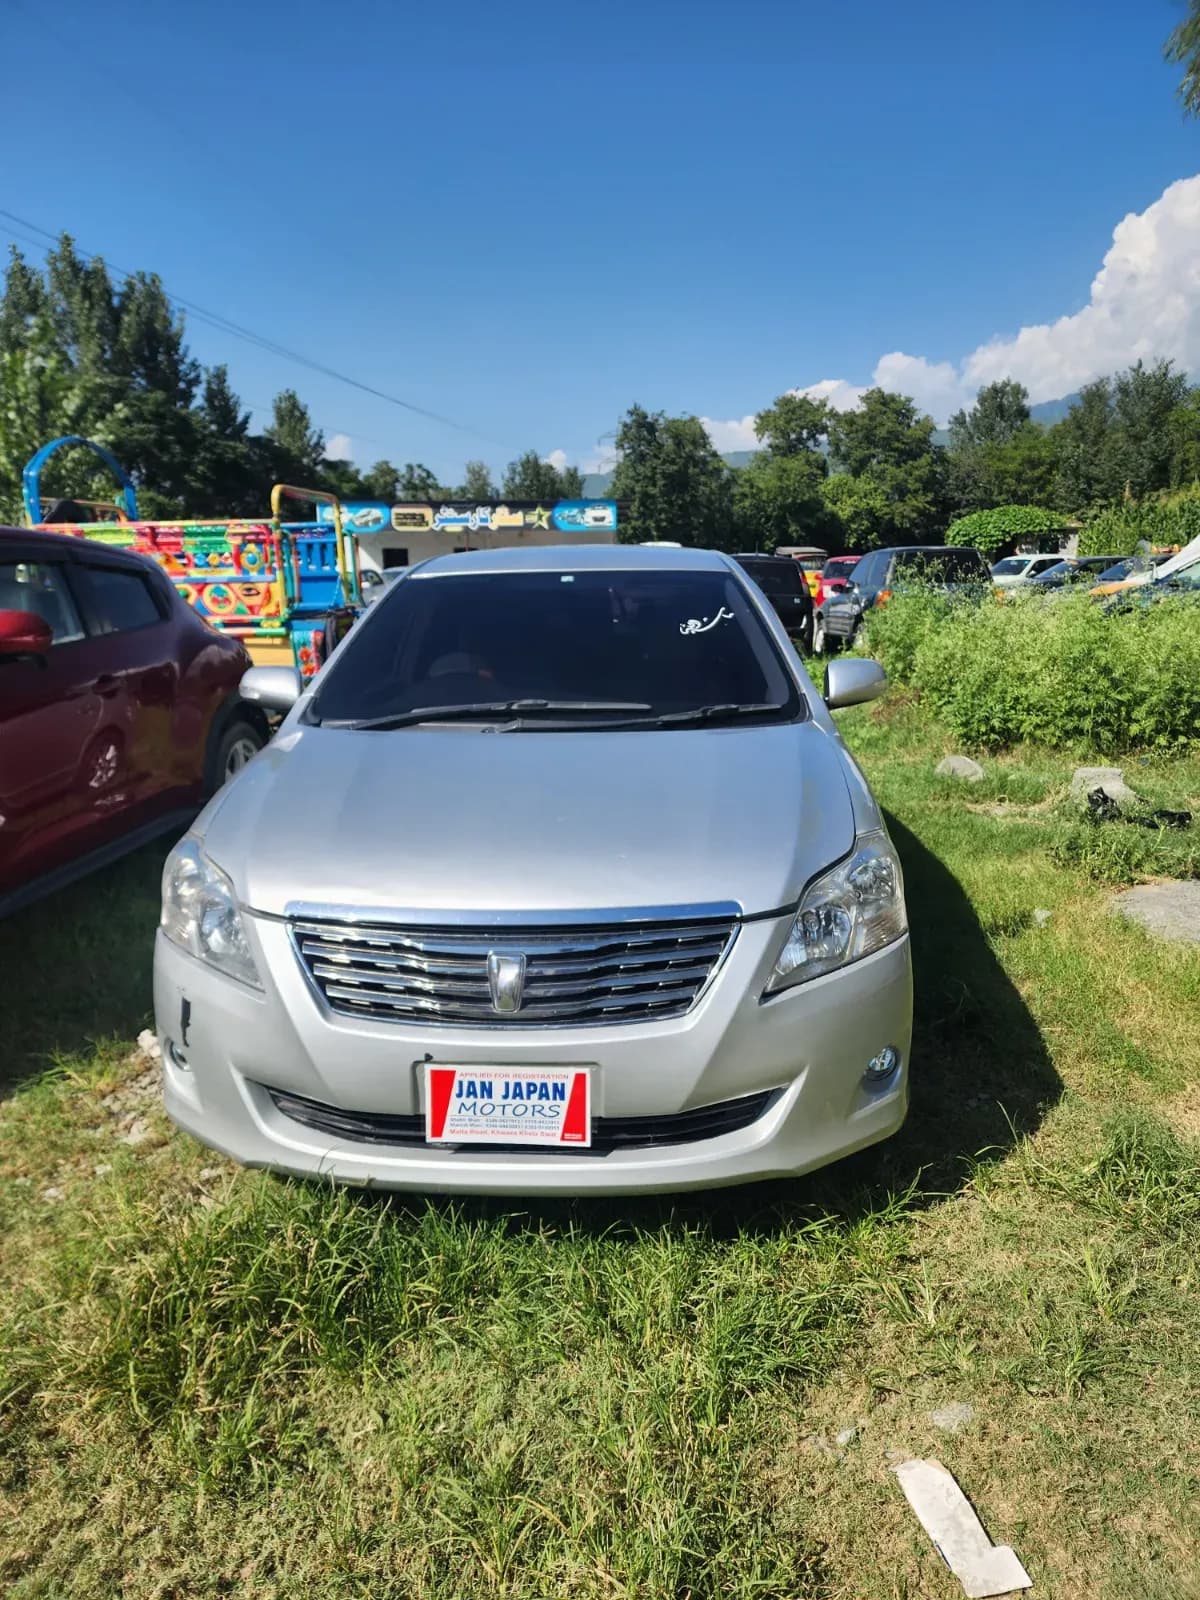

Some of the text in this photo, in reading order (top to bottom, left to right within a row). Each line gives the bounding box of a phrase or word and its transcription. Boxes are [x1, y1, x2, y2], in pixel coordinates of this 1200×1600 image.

[456, 1080, 566, 1101] JAN JAPAN
[458, 1102, 561, 1118] MOTORS
